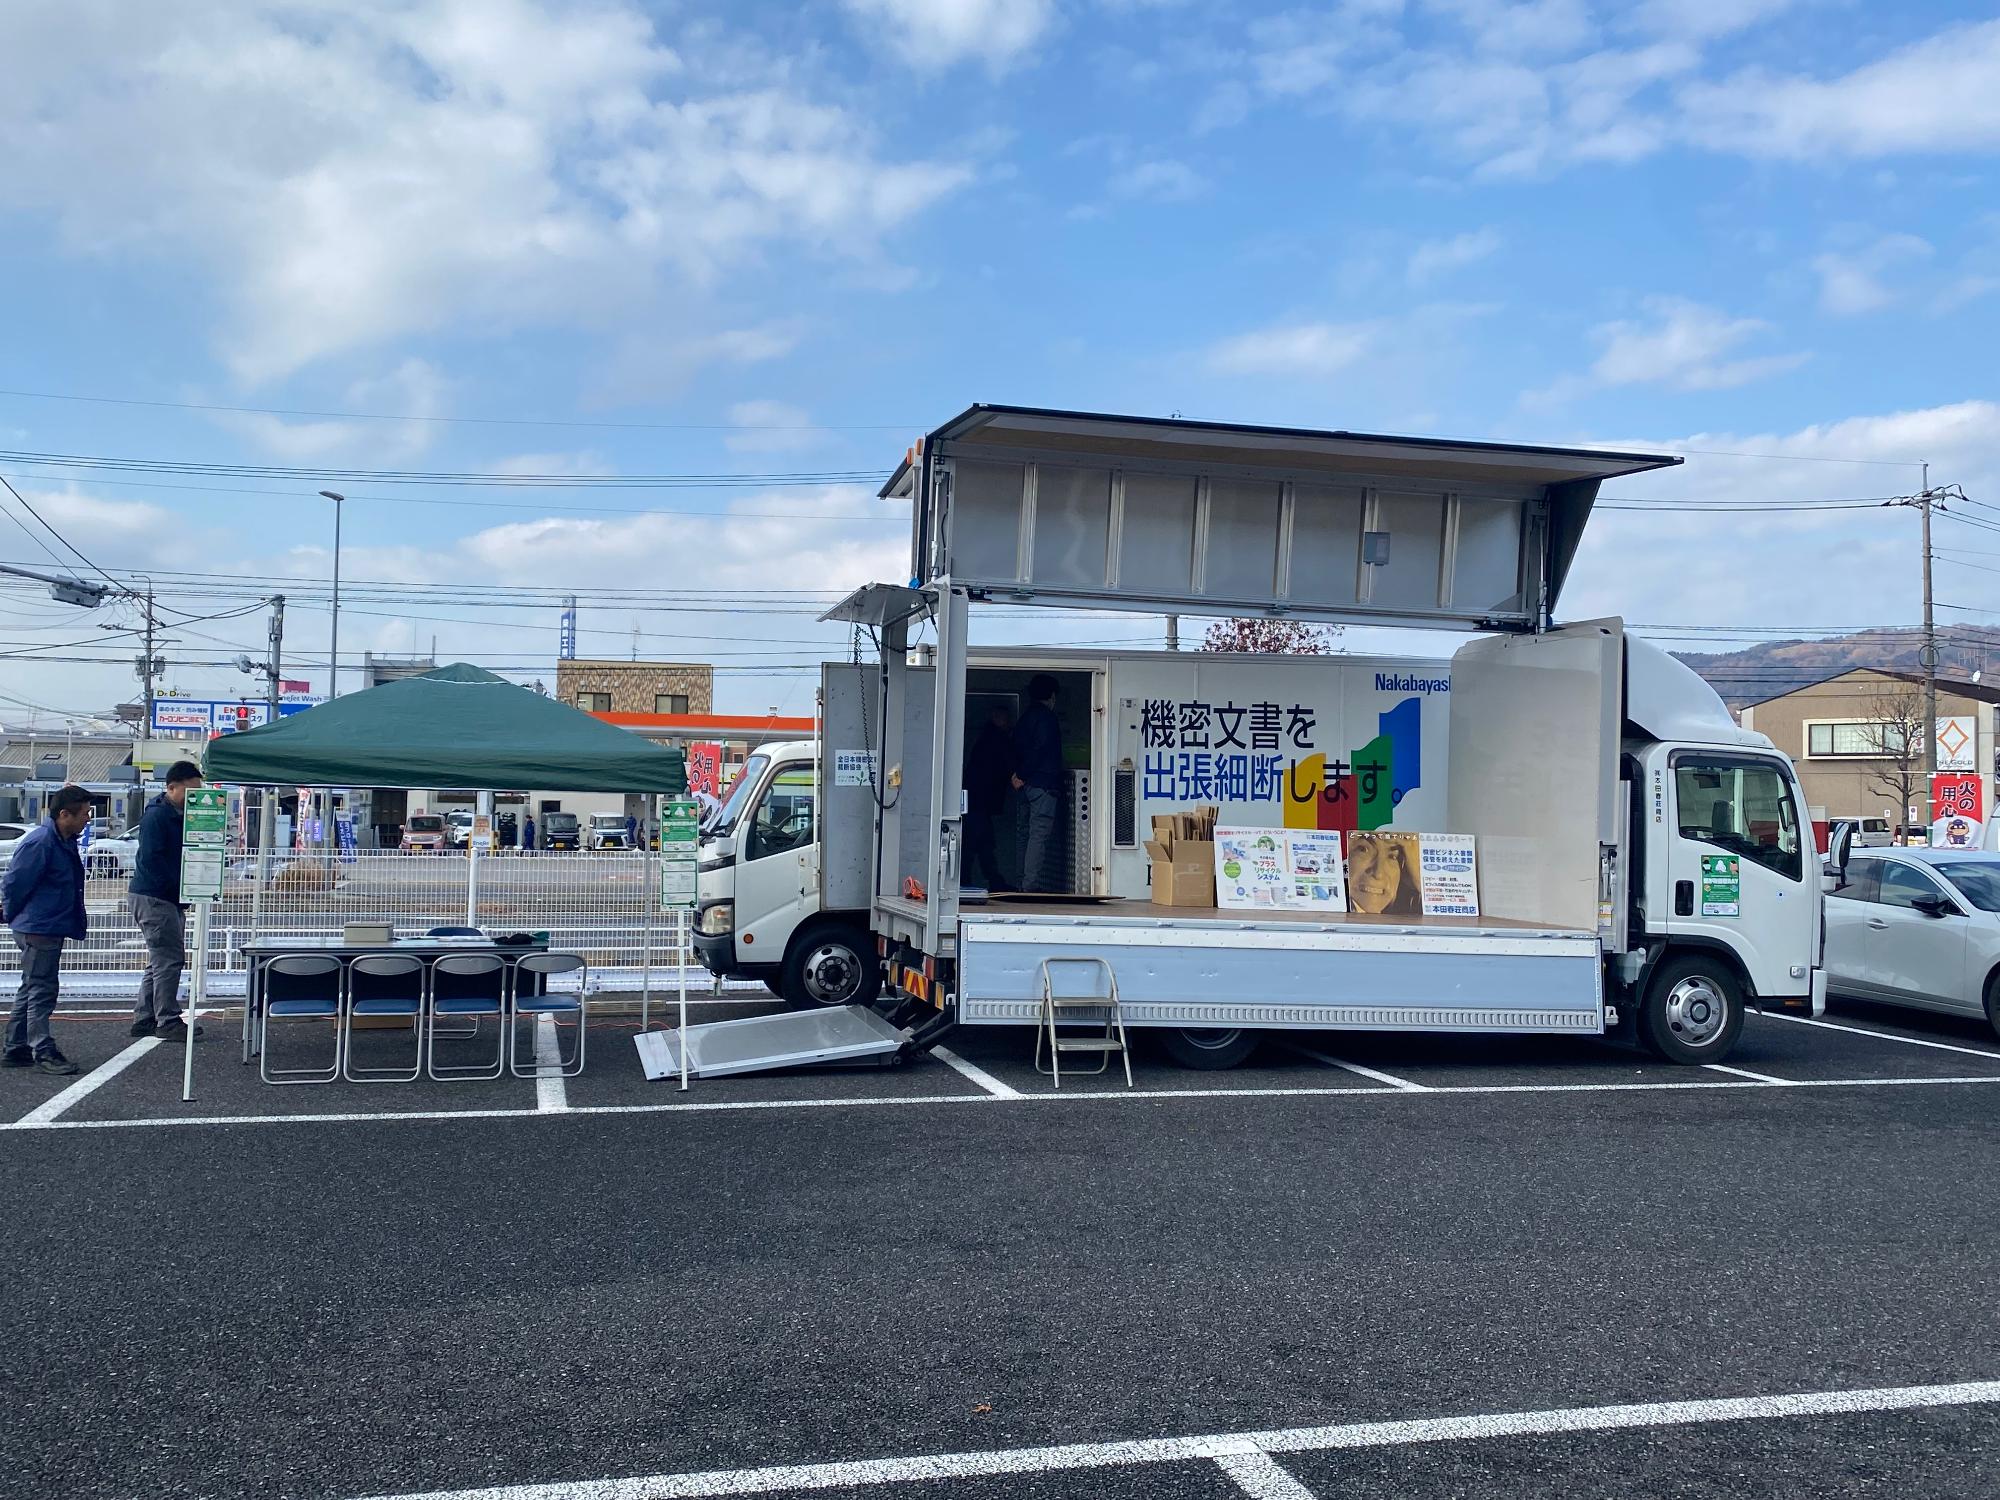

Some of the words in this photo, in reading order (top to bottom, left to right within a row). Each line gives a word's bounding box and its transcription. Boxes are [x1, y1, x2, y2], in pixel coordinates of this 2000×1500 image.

[1375, 673, 1450, 695] Nakabayas
[1140, 699, 1316, 751] 機密文書を
[1143, 752, 1402, 807] 出張細断します。
[1940, 786, 1957, 818] 用心
[1958, 781, 1976, 811] 火の
[1257, 873, 1280, 881] システム
[1259, 860, 1276, 868] プラス
[1432, 904, 1477, 914] 本田春荘商店
